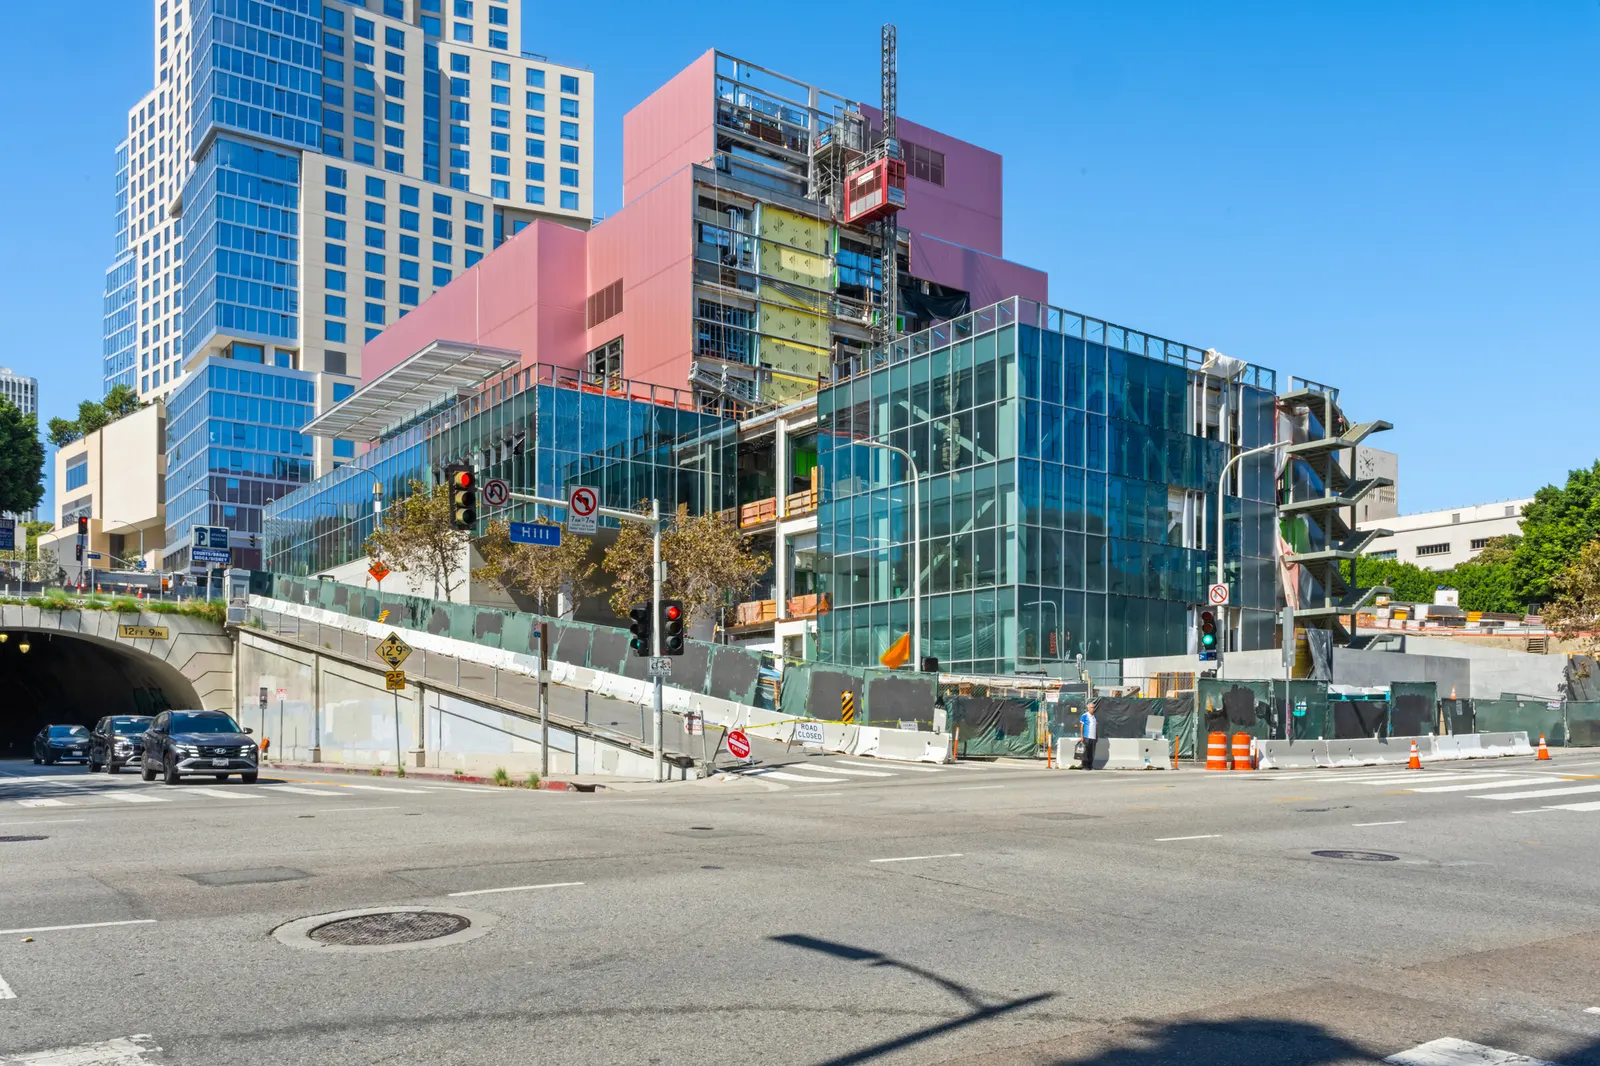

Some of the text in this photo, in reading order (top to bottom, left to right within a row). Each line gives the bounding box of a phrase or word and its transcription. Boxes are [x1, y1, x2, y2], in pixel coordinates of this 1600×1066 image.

[522, 527, 548, 539] Hill
[798, 731, 822, 740] CLOSED
[732, 745, 744, 754] ENTER
